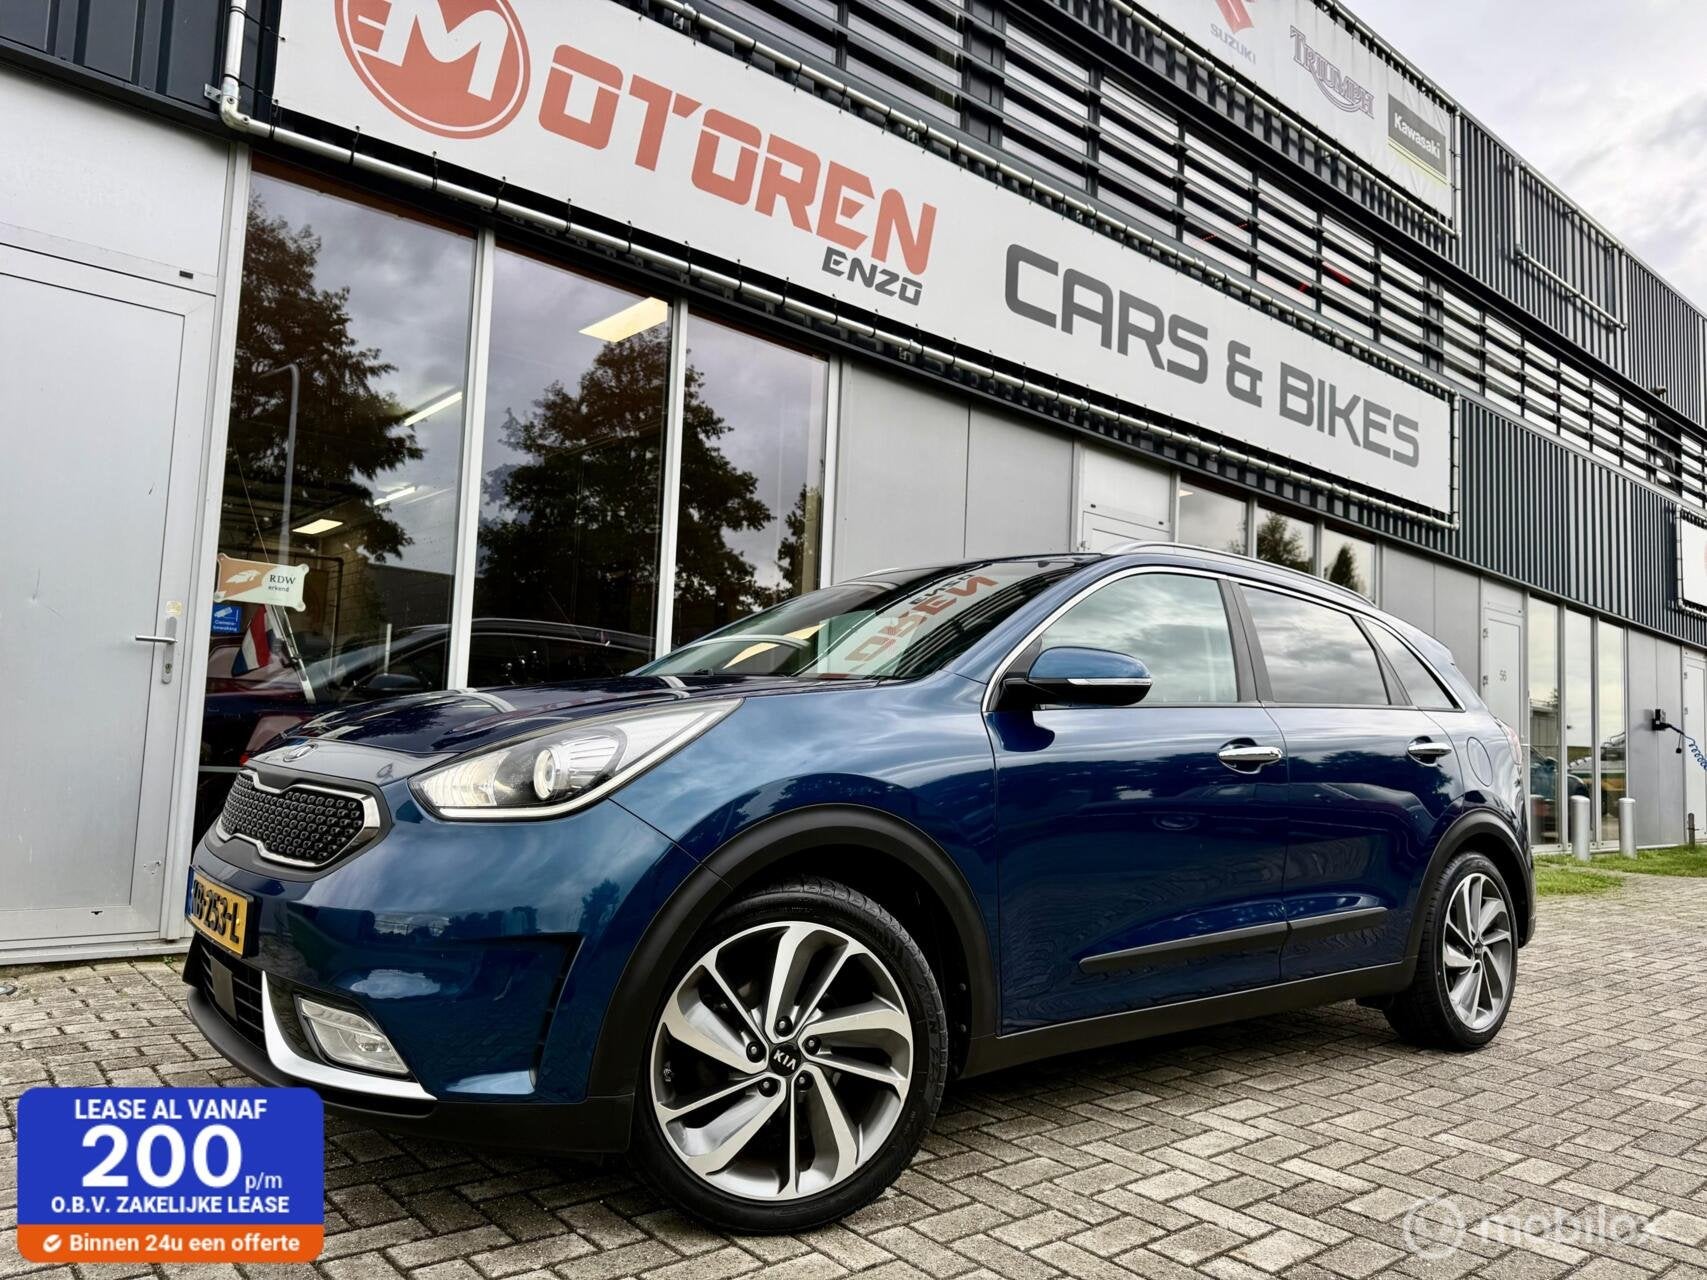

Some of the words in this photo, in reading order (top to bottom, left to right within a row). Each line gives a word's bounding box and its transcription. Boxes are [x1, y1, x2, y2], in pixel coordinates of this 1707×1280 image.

[1210, 23, 1257, 65] SUZUKI
[1290, 24, 1375, 119] TRIUMPH
[1393, 112, 1441, 160] Kawasaki
[822, 246, 924, 305] ENZO
[1004, 243, 1209, 385] CARS
[1225, 340, 1263, 408] &
[1279, 361, 1420, 468] BIKES
[268, 585, 289, 593] erkend
[269, 574, 296, 585] RDW
[773, 1049, 797, 1071] KIA
